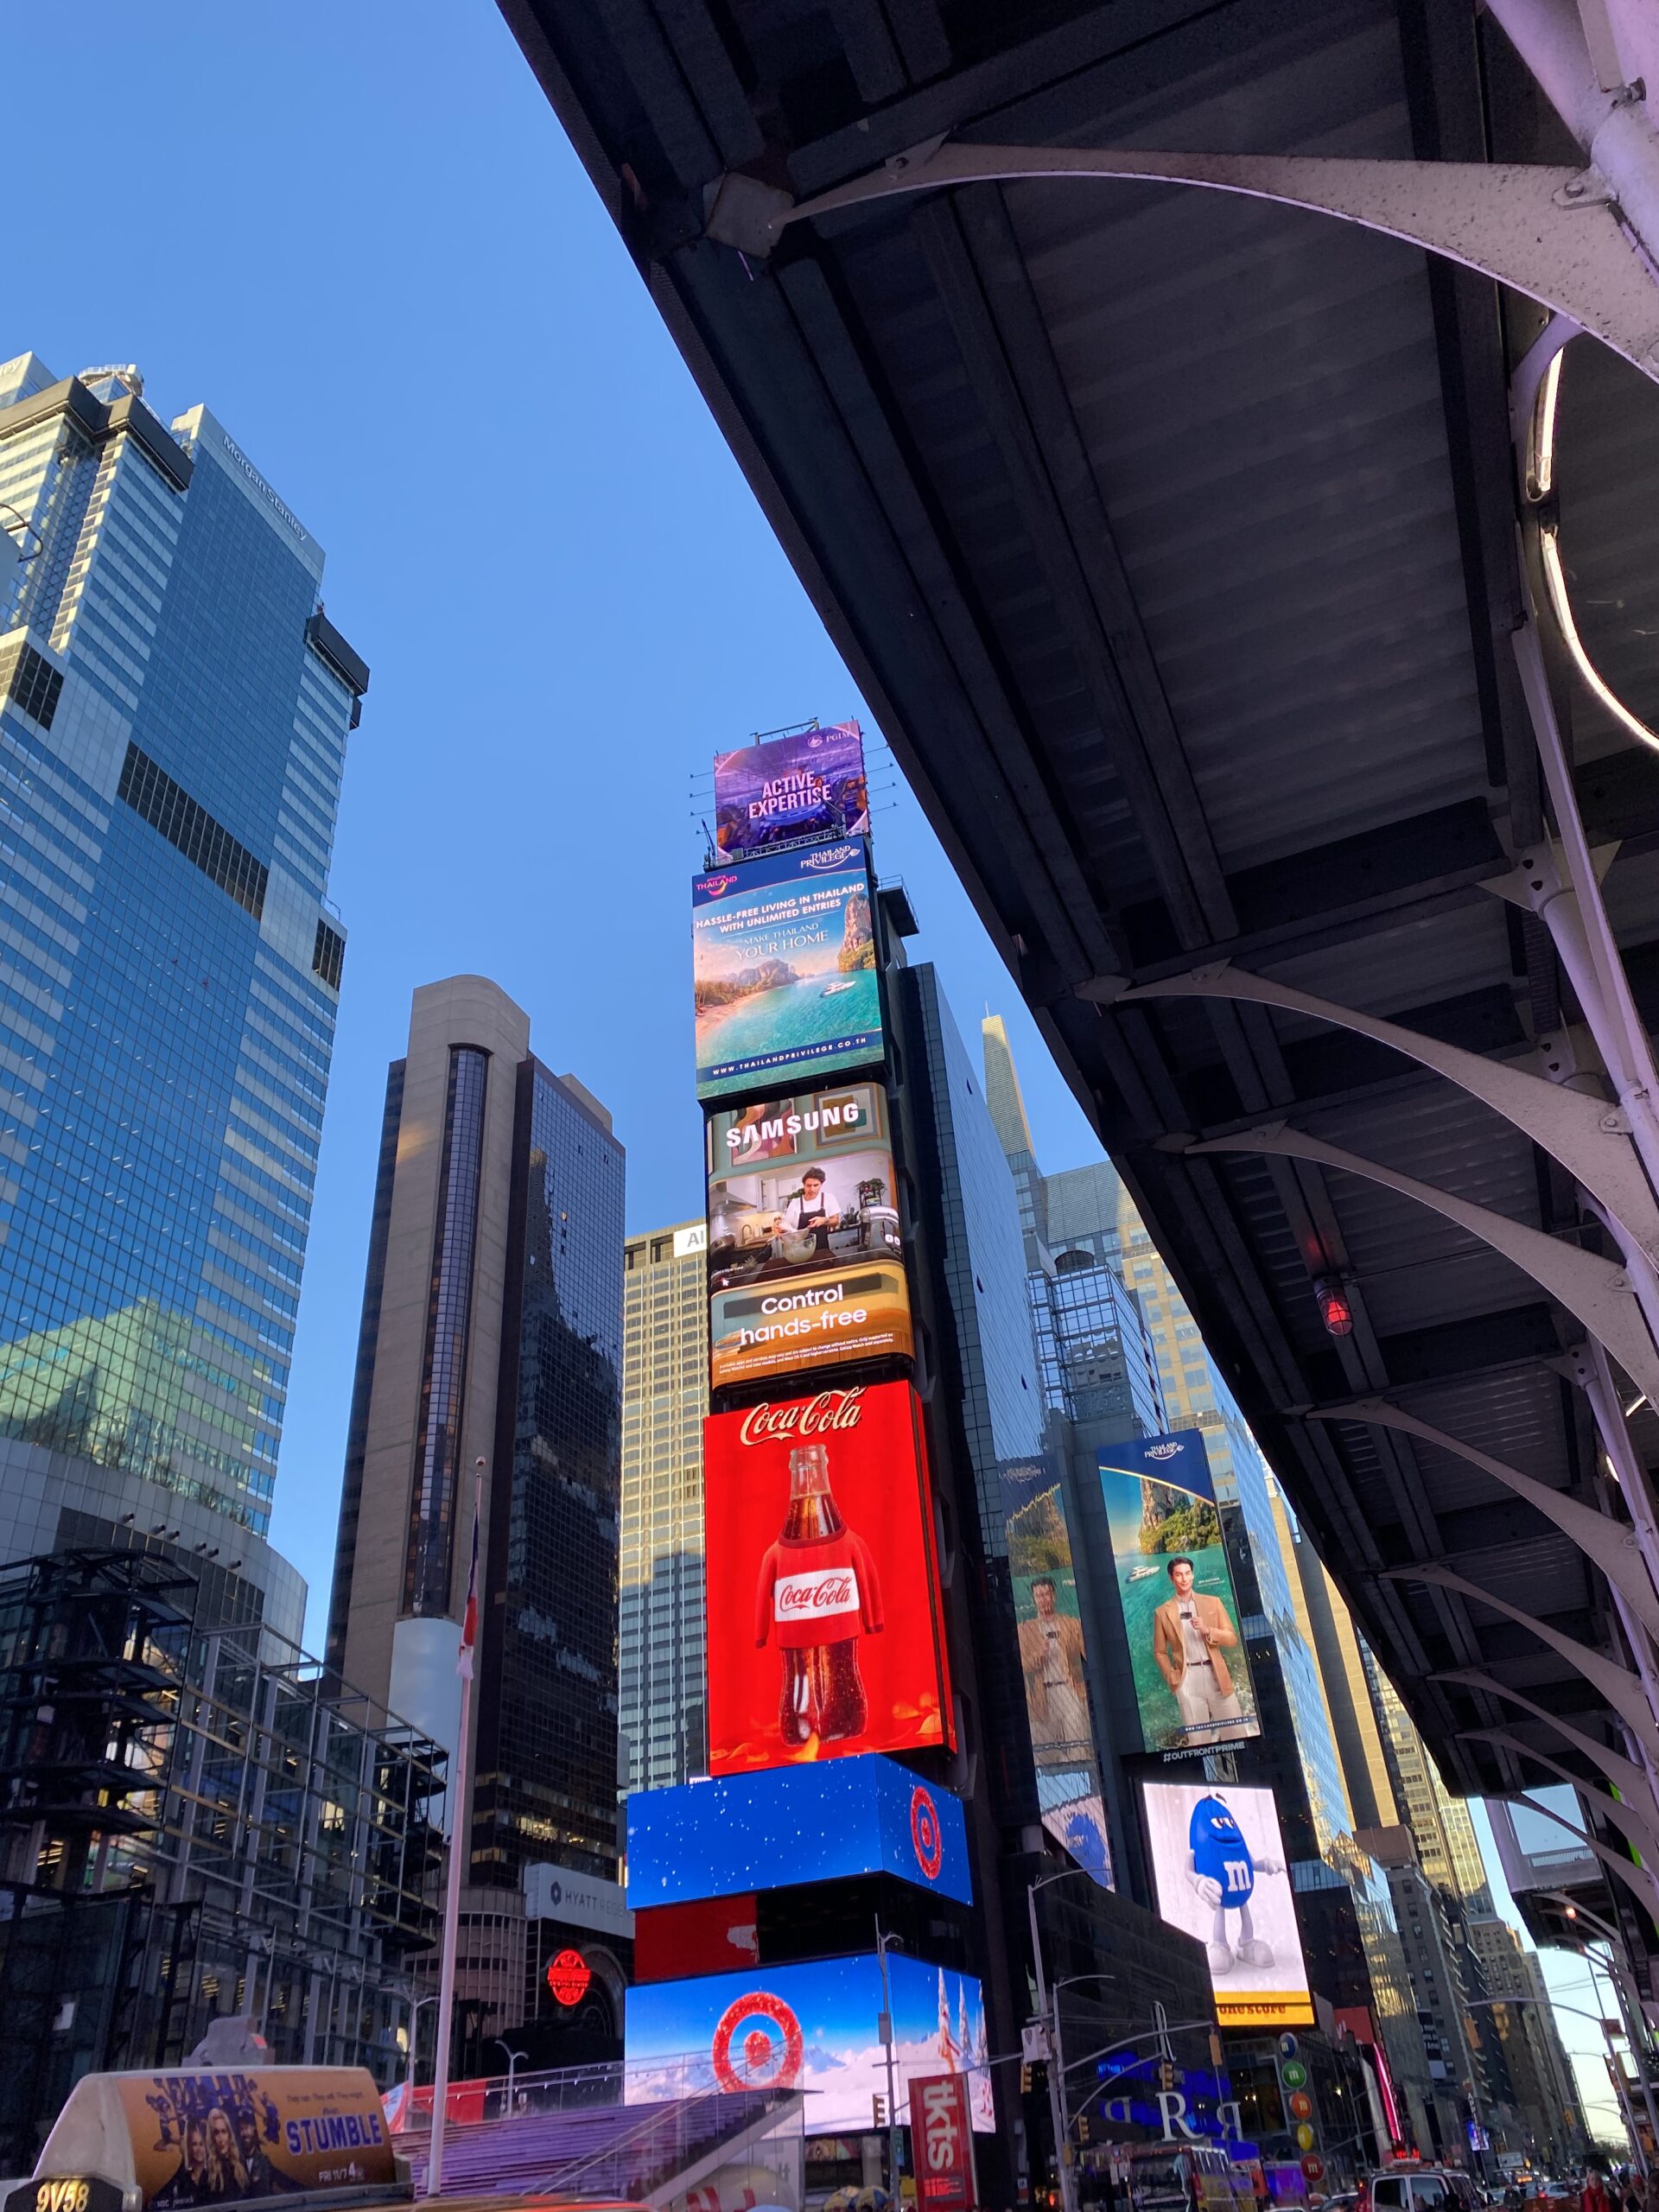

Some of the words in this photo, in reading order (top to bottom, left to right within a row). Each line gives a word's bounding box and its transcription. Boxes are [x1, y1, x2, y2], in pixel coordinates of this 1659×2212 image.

[223, 435, 266, 492] Morgan
[266, 488, 307, 541] Stanley
[826, 733, 851, 743] PGIM
[762, 771, 816, 798] ACTIVE
[748, 785, 832, 819] EXPERTISE
[800, 851, 848, 868] PRIVILEGE
[810, 845, 851, 859] THAILAND
[696, 875, 738, 890] THAILAND
[696, 908, 759, 929] HASSLE-FREE
[761, 899, 797, 913] LIVING
[799, 895, 810, 905] IN
[813, 883, 864, 901] THAILAND
[720, 921, 744, 934] WITH
[747, 909, 799, 927] UNLIMITED
[802, 899, 842, 914] ENTRIES
[735, 941, 779, 961] YOUR
[783, 930, 830, 950] HOME
[744, 934, 770, 945] MAKE
[773, 923, 819, 939] THAILAND
[713, 1037, 867, 1076] WWW.THAILANDPRIVILEGE.CO.TH
[726, 1103, 860, 1147] SAMSUNG
[761, 1284, 843, 1315] Control
[740, 1308, 868, 1345] hands-free
[740, 1386, 868, 1446] Coca-Cola
[1150, 1441, 1178, 1452] THAILAND
[779, 1576, 853, 1612] Coca-Cola
[1163, 1741, 1246, 1763] #OUTFRONTPRIME
[1224, 1860, 1252, 1892] m
[565, 1889, 598, 1910] HYATT
[1288, 2069, 1300, 2080] m
[1155, 2091, 1205, 2142] R
[1299, 2101, 1308, 2111] m
[286, 2113, 383, 2156] STUMBLE
[924, 2080, 958, 2171] tkts
[319, 2171, 332, 2182] FRI
[1307, 2164, 1319, 2173] m
[36, 2182, 89, 2212] 9V58
